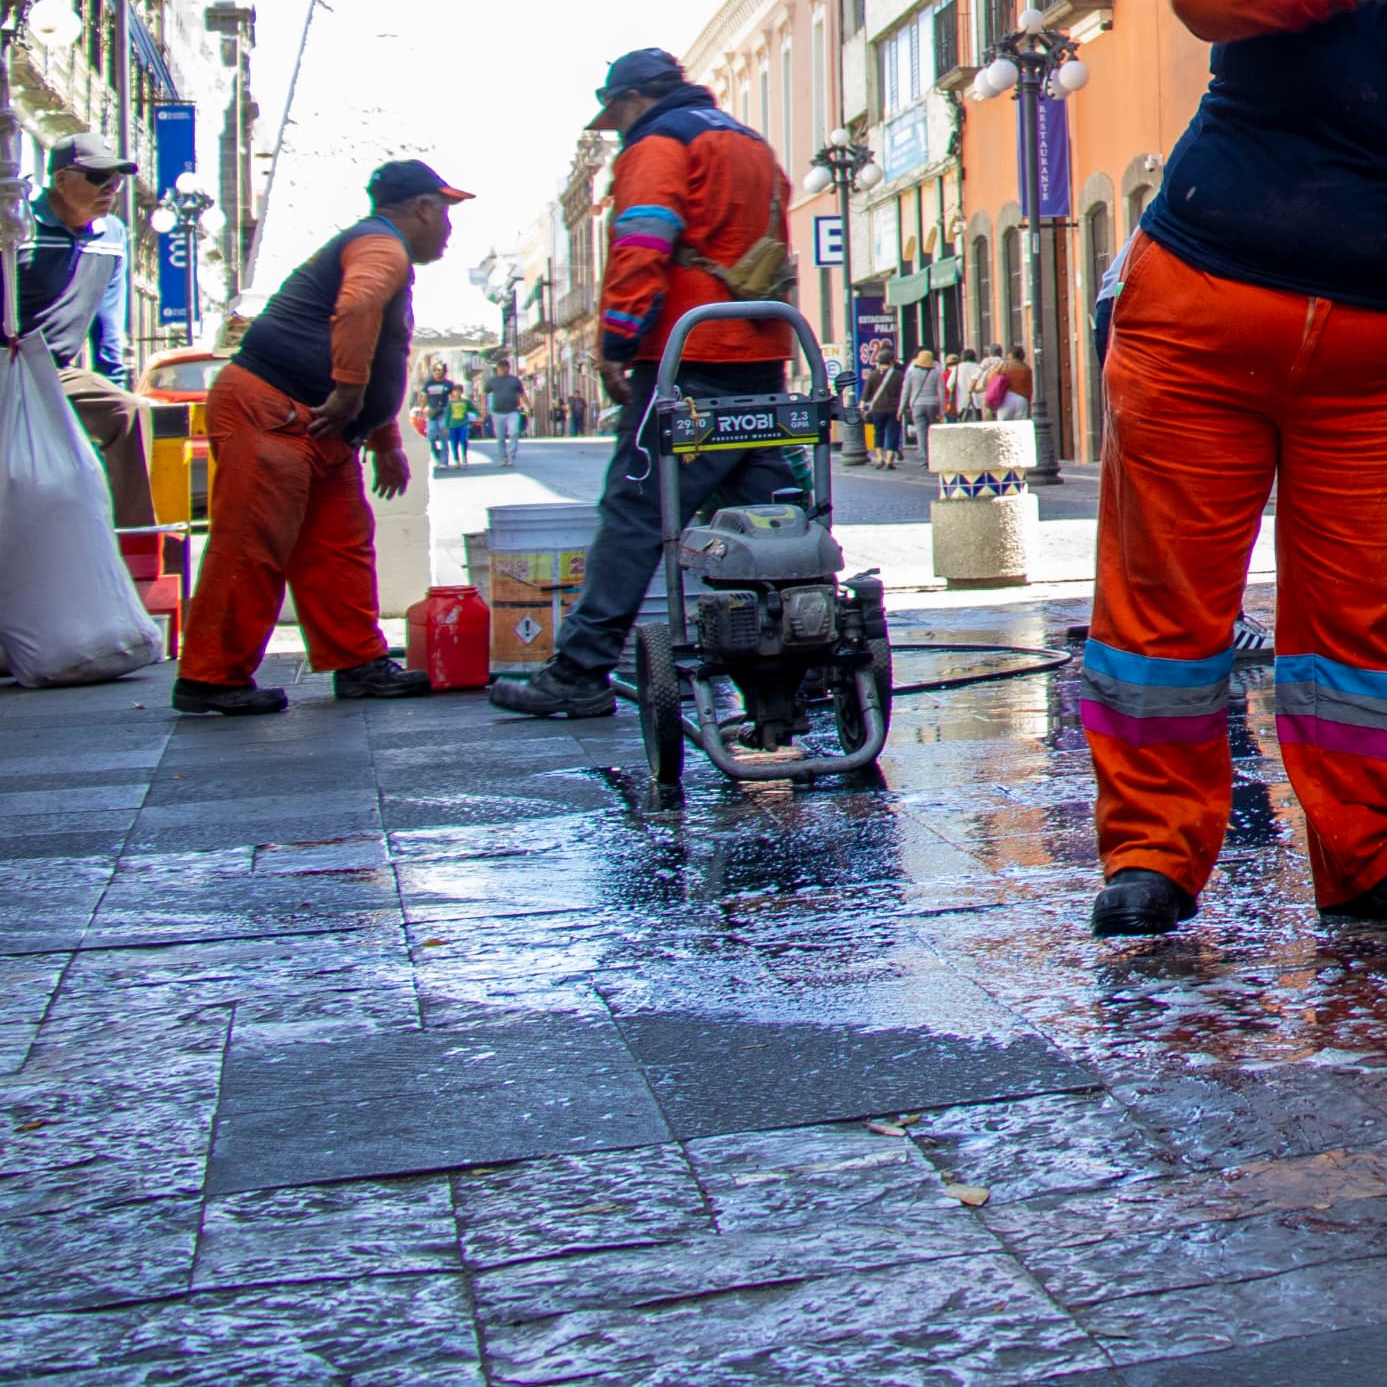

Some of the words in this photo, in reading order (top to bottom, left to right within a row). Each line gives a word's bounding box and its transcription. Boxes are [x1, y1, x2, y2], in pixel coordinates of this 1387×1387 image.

[1039, 105, 1049, 201] RESTAURANTE
[718, 413, 775, 433] RYOBI
[790, 411, 809, 421] 2.3
